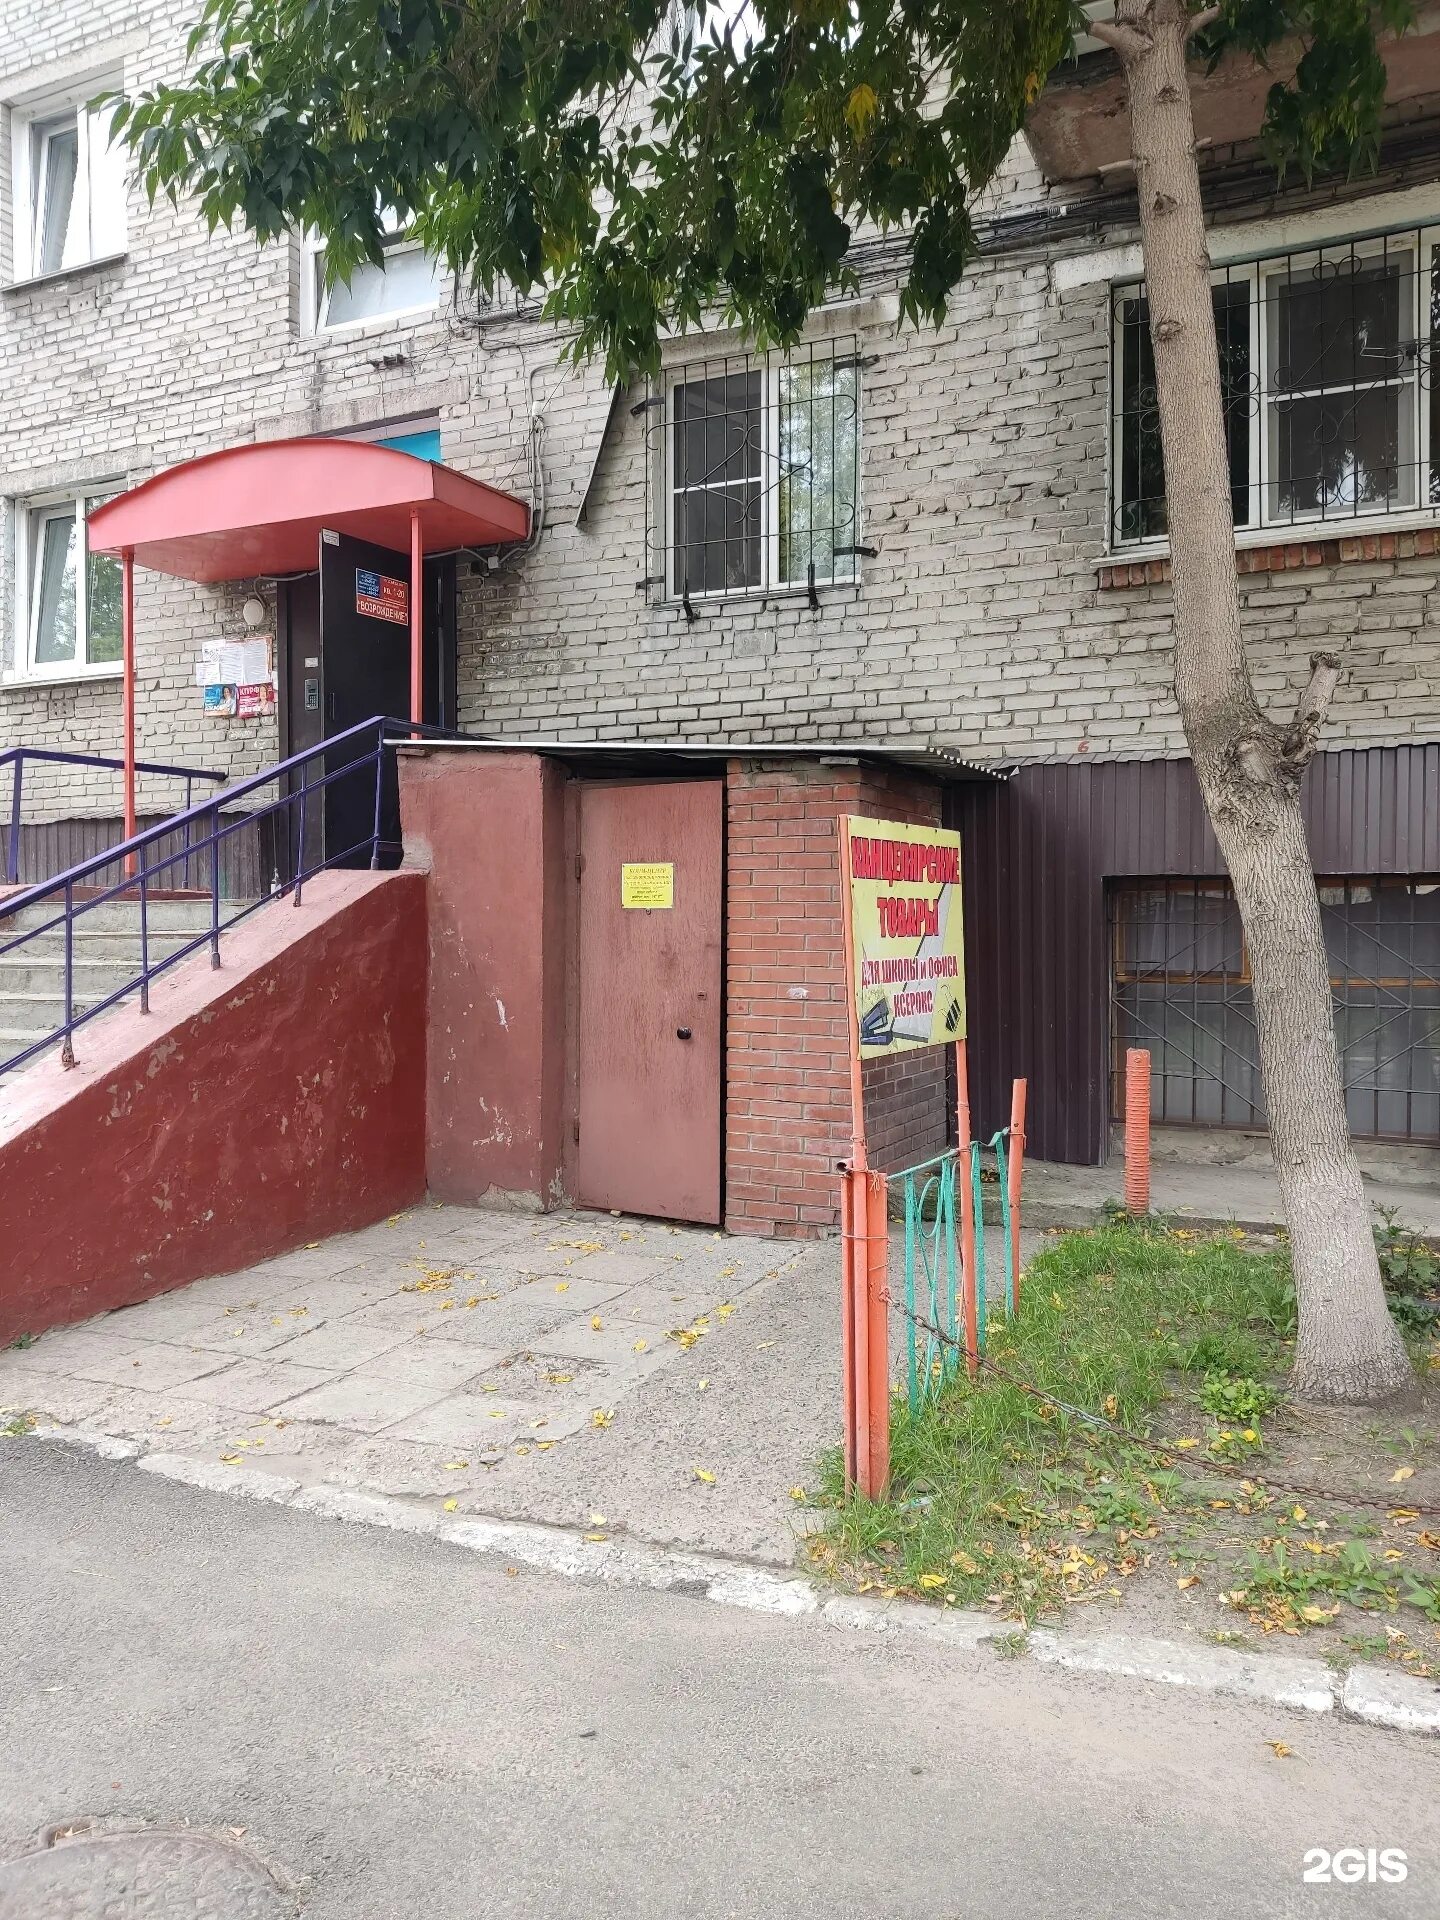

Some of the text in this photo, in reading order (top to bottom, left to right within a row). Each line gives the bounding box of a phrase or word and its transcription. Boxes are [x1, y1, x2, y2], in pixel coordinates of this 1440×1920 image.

[239, 686, 260, 696] КПРФ
[1077, 740, 1090, 753] 6
[851, 836, 961, 887] КАНЦЕЛЯРСКИЕ
[877, 897, 939, 938] ТОВАРЫ
[861, 959, 881, 989] ДЛЯ
[882, 956, 919, 984] ШКОЛЫ
[928, 955, 959, 982] ОФИСА
[893, 989, 934, 1018] КСЕРОКС
